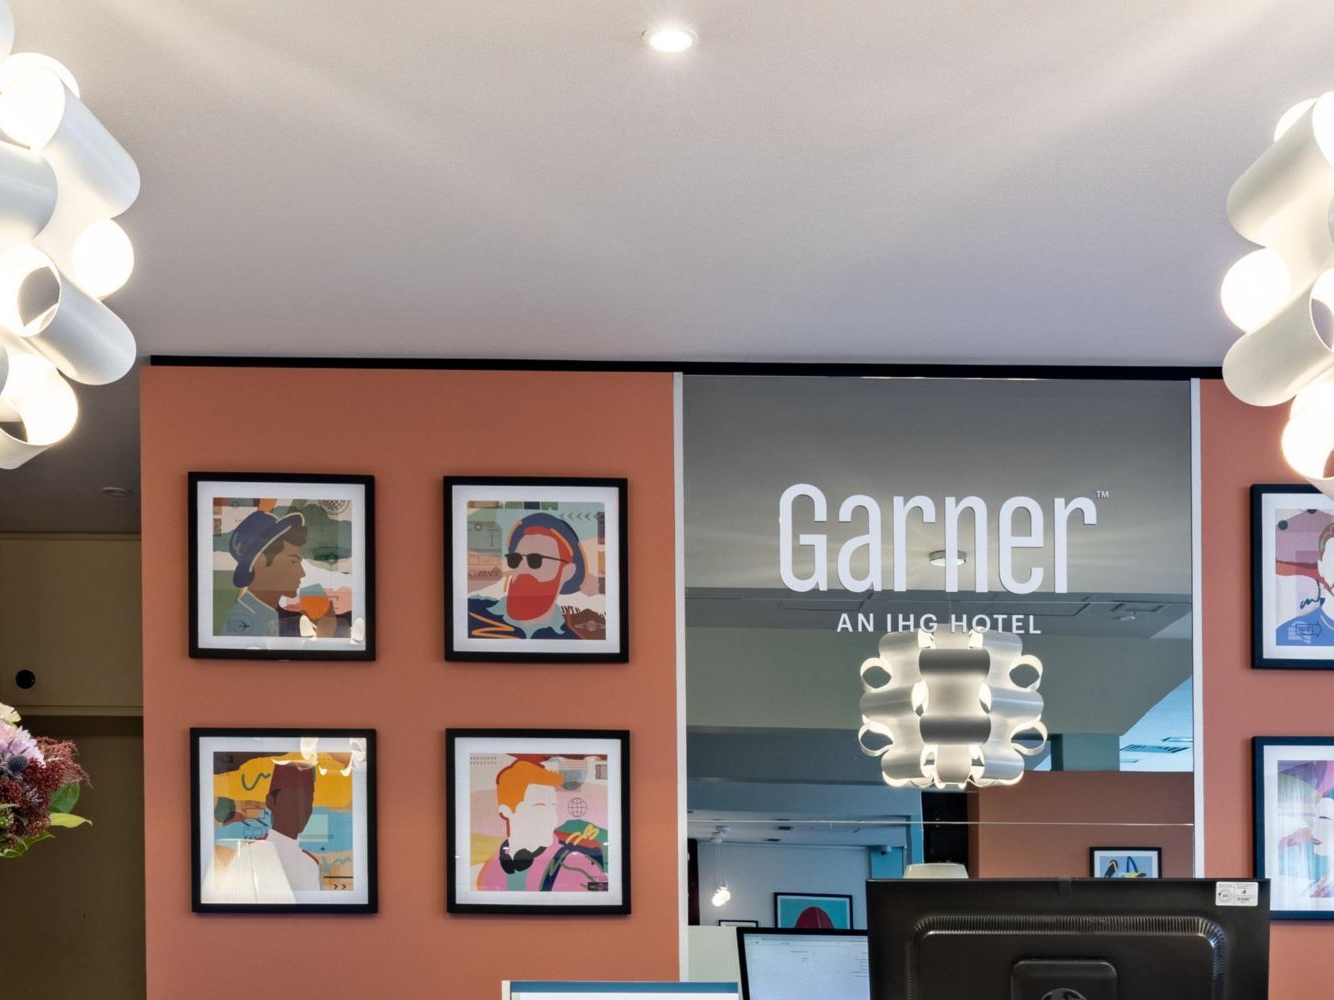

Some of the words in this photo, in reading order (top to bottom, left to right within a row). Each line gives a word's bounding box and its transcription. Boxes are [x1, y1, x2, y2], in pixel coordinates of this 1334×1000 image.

[779, 483, 1097, 594] Garner
[836, 613, 874, 633] AN
[887, 613, 938, 633] IHG
[951, 613, 1042, 634] HOTEL
